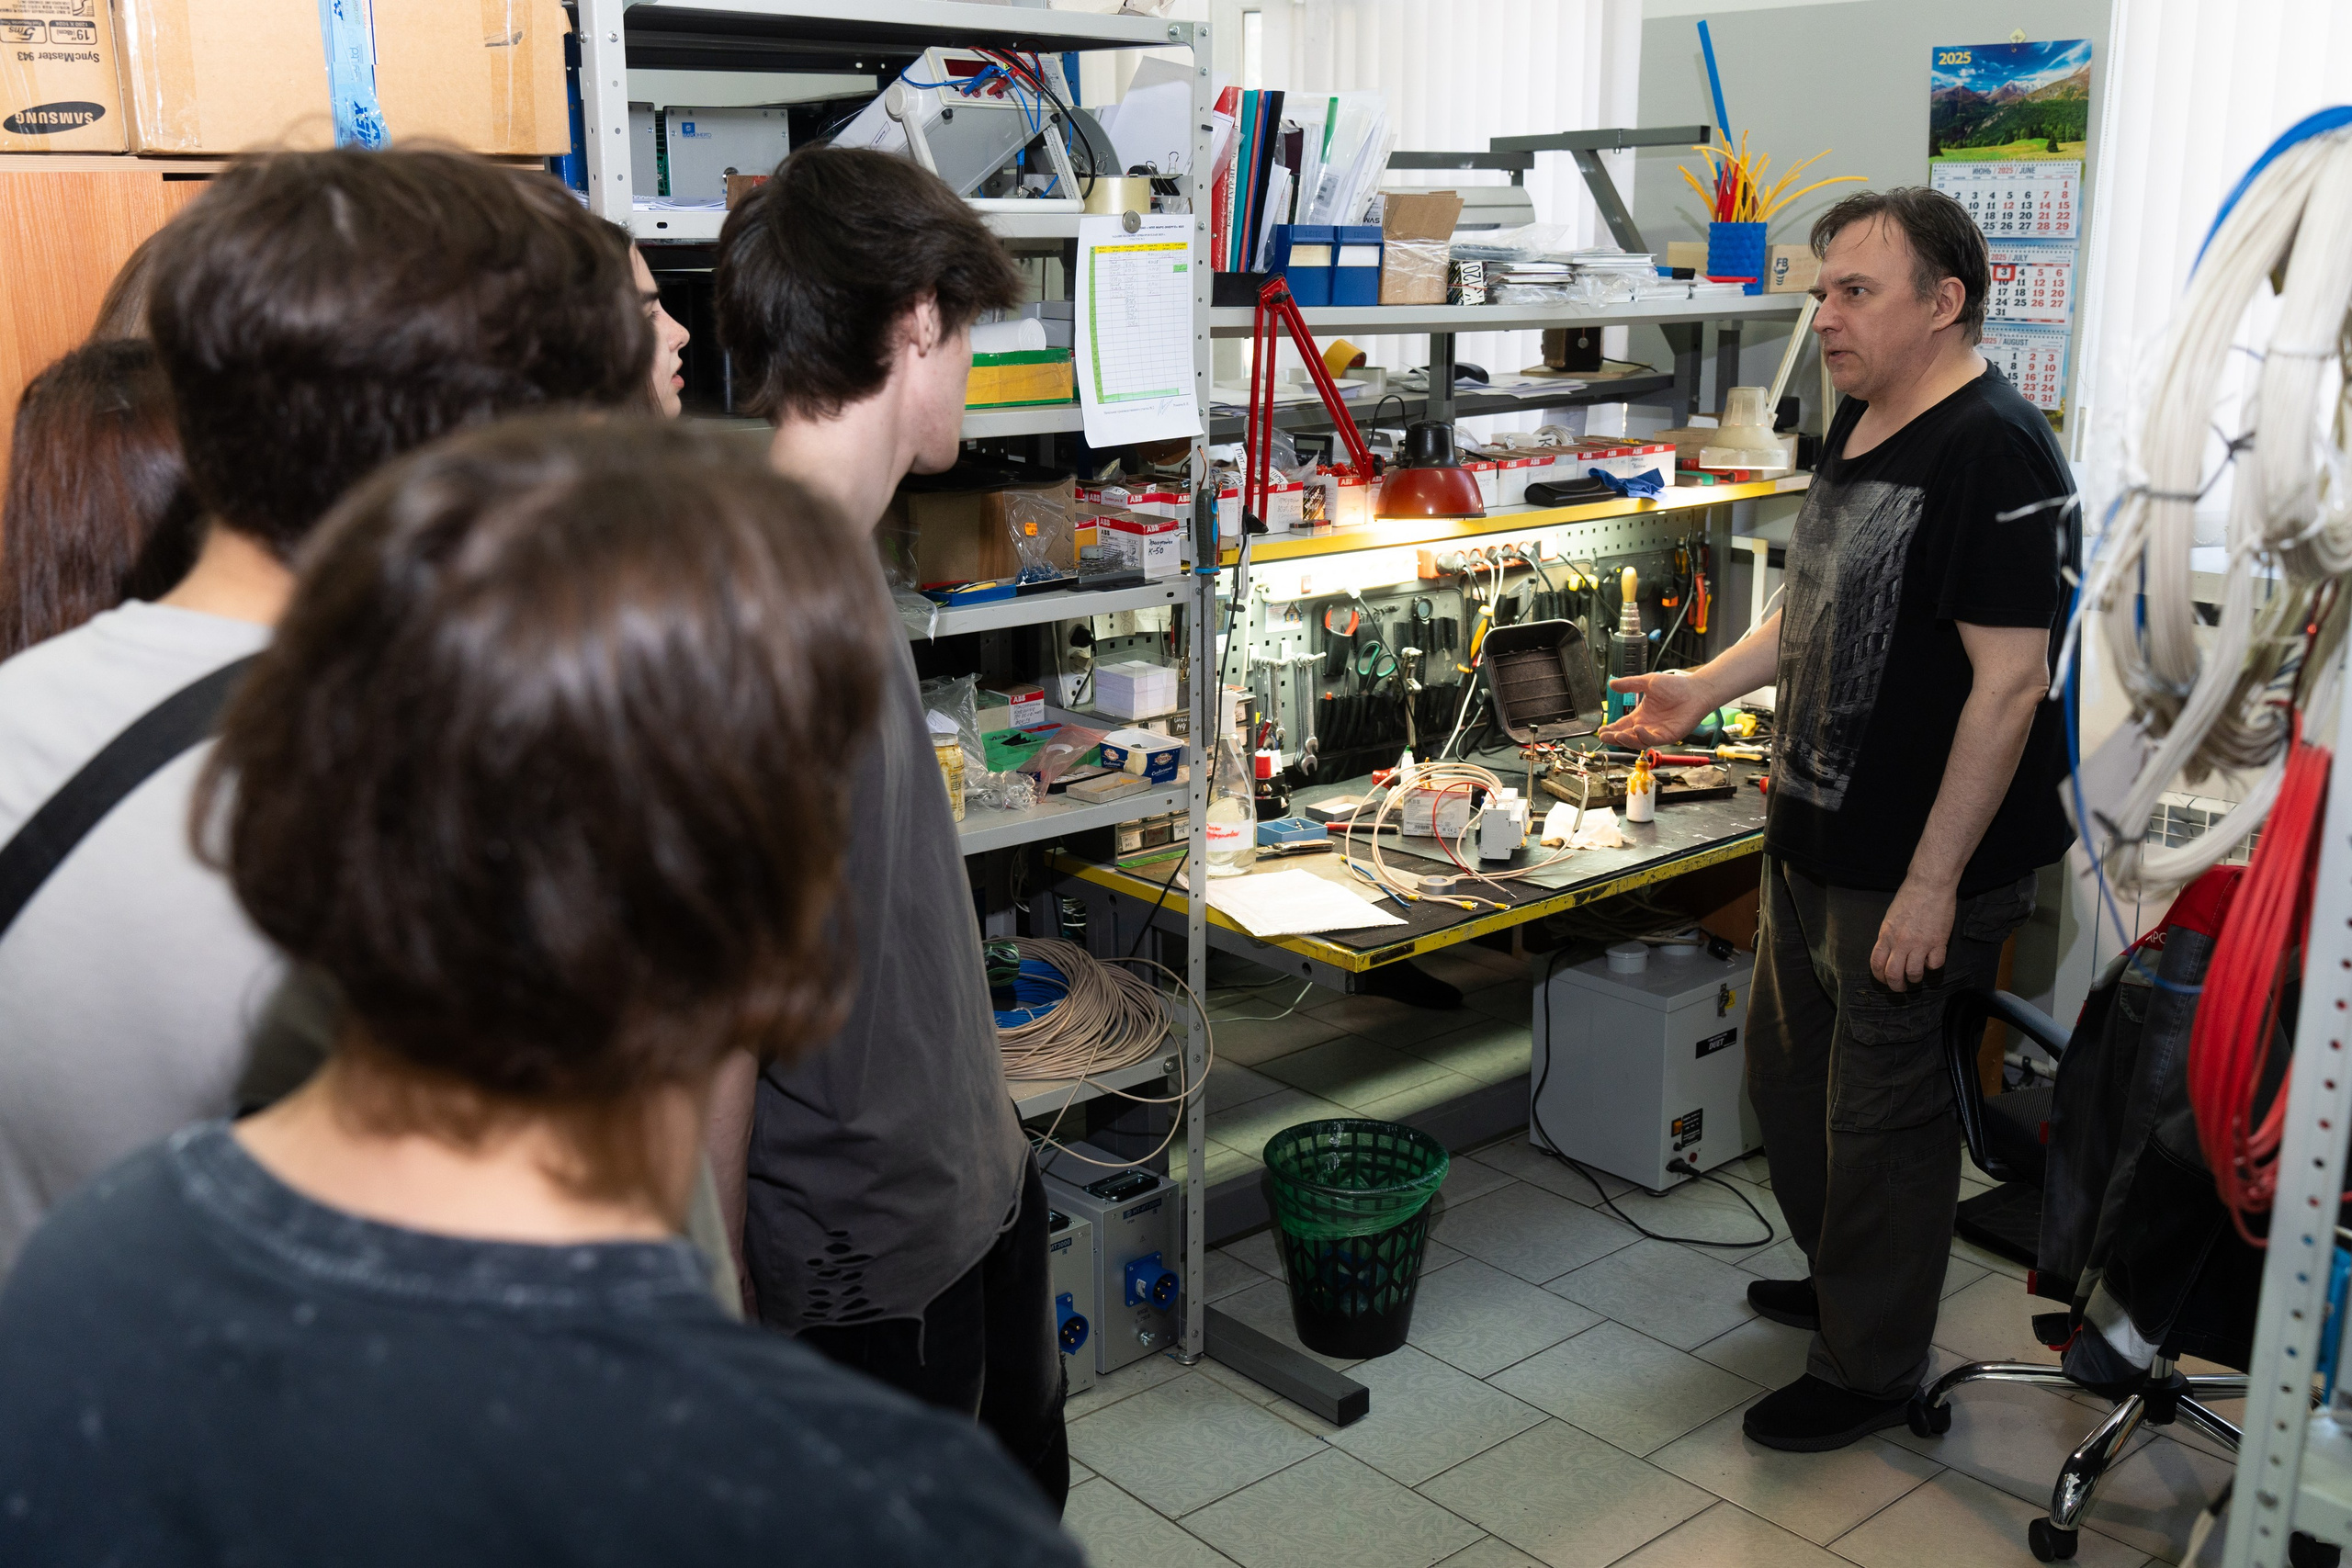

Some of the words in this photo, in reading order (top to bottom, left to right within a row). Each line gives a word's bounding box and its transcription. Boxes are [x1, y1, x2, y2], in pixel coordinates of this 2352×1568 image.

[17, 51, 35, 62] 943
[38, 51, 100, 63] SyncMaster
[1939, 51, 1972, 65] 2025
[14, 111, 95, 125] SAMSUNG
[1776, 257, 1789, 267] FB
[2044, 364, 2056, 372] 10
[2041, 384, 2054, 392] 24
[1089, 493, 1101, 502] ABB
[1129, 495, 1143, 503] ABB
[1177, 494, 1191, 503] ABB
[1099, 517, 1111, 527] ABB
[1147, 524, 1159, 534] ABB
[1012, 694, 1026, 704] ABB
